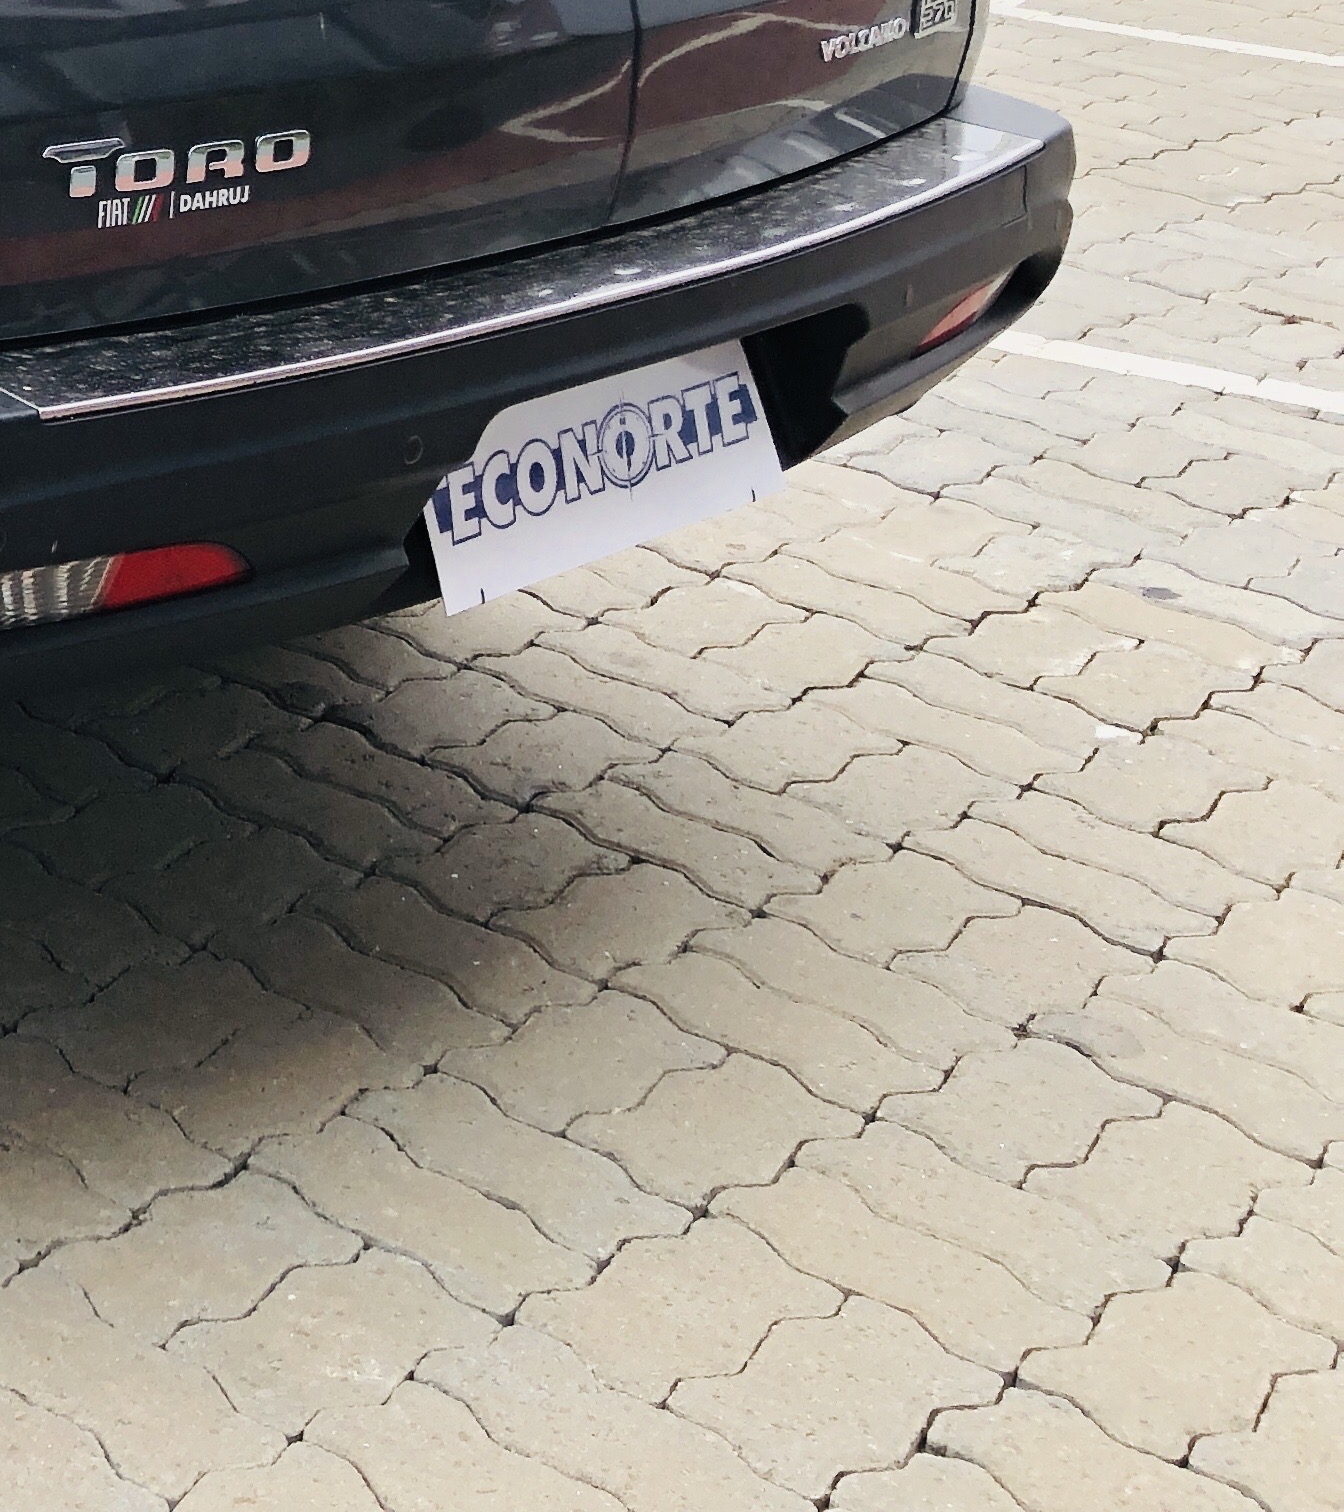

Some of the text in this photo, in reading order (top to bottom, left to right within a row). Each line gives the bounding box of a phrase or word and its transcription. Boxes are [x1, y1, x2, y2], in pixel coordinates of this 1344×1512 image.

[921, 0, 957, 28] 270
[820, 16, 908, 63] VOLCANO
[42, 129, 311, 199] TORO
[97, 185, 250, 229] FIAT DAHRUJ
[444, 370, 752, 546] ECONORTE
